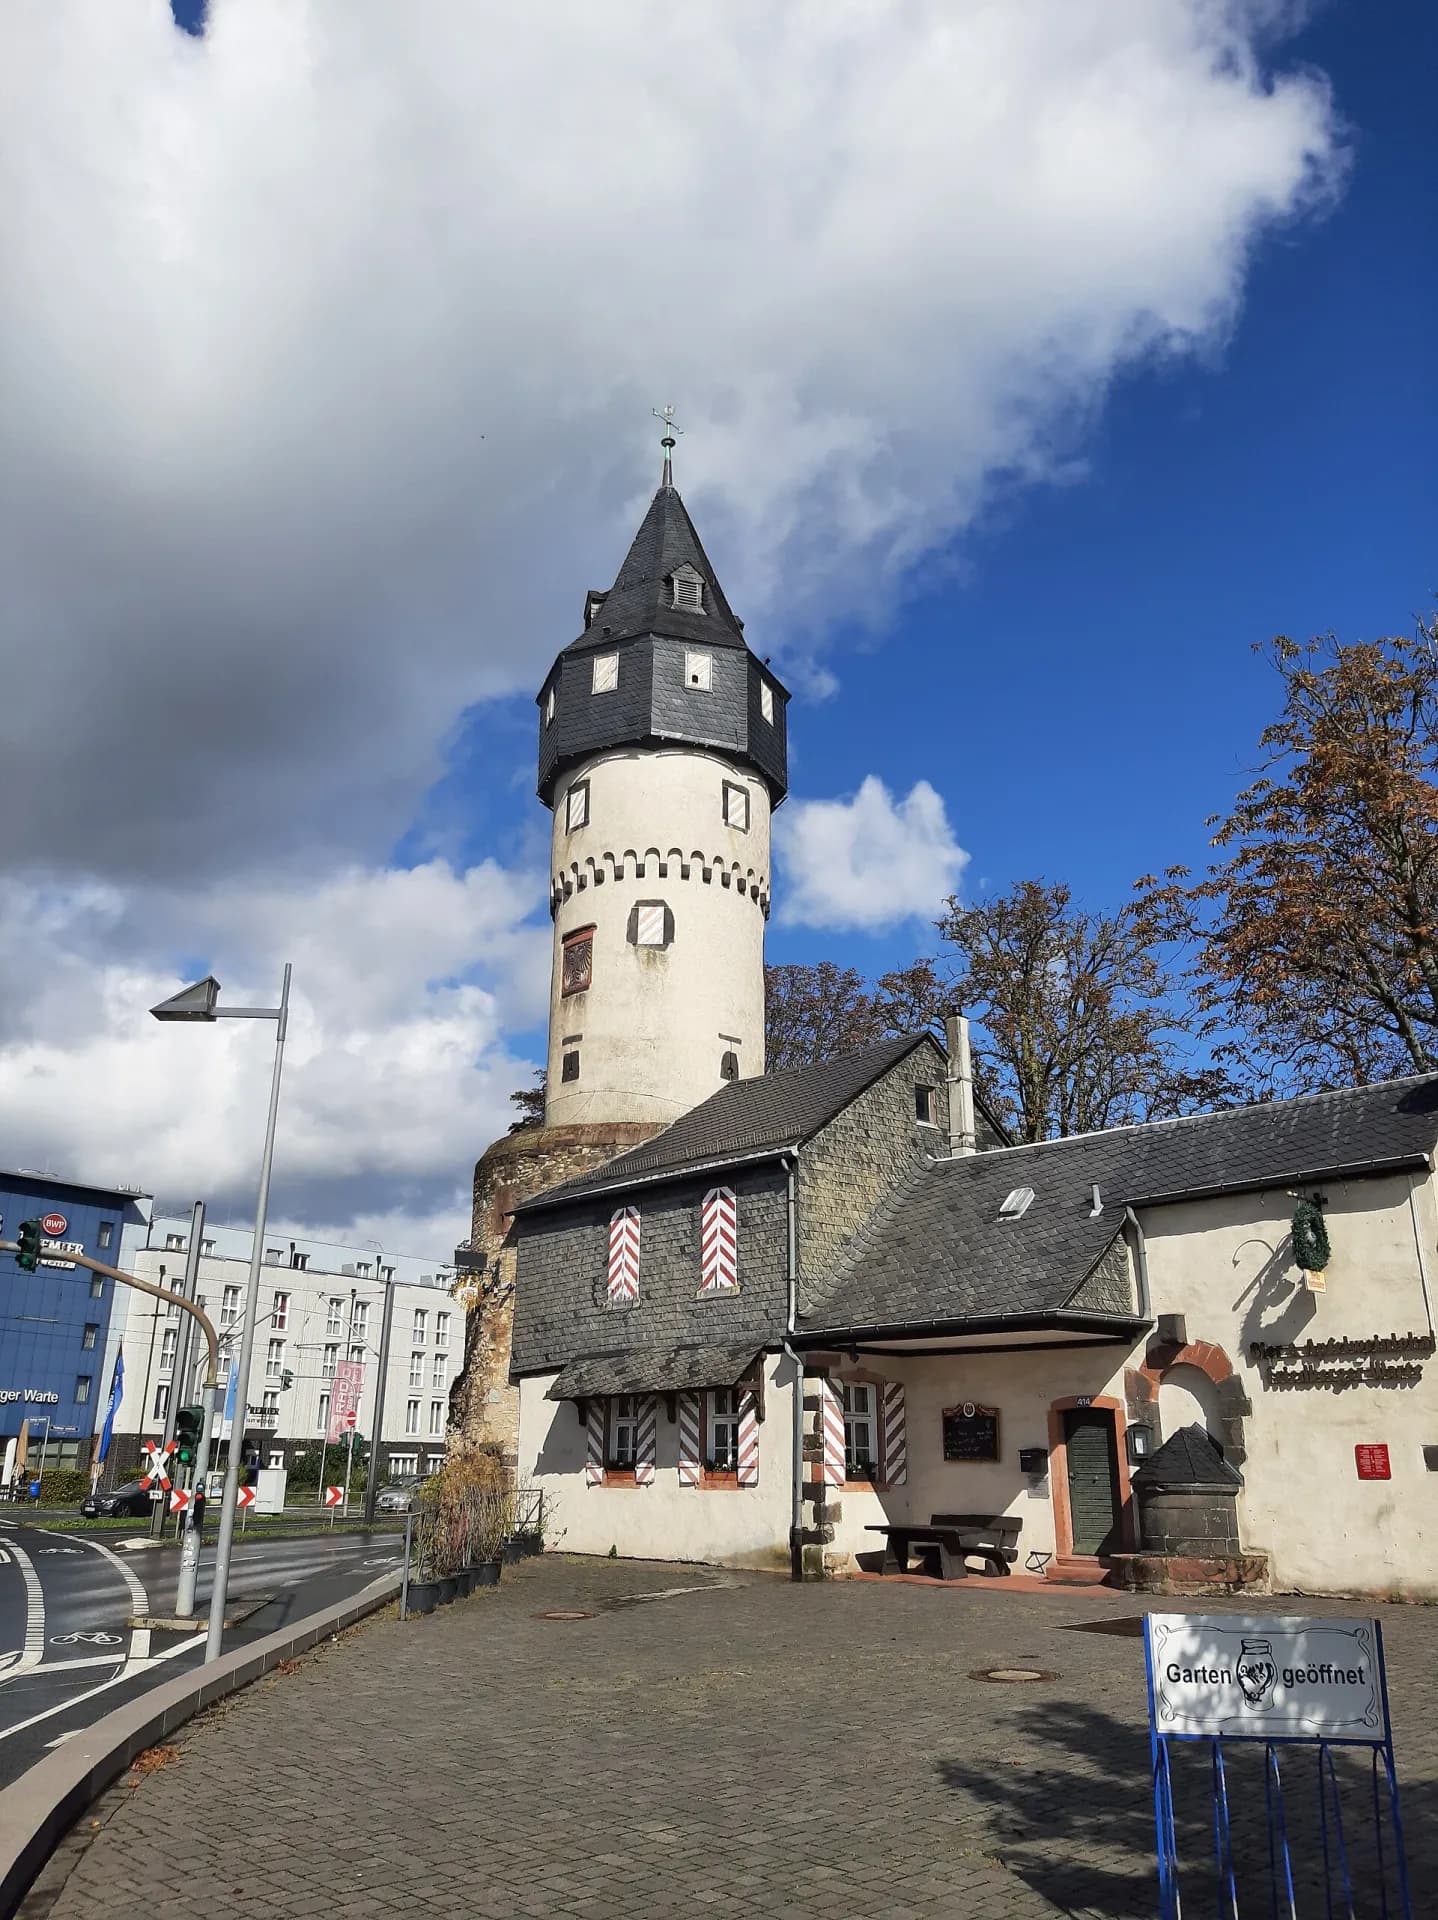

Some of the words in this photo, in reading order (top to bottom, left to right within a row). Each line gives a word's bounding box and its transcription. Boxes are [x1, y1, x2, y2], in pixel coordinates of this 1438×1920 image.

[46, 1219, 65, 1229] BWP
[0, 1390, 21, 1403] ger
[24, 1389, 59, 1403] Warte
[1077, 1398, 1090, 1406] 414
[1166, 1663, 1232, 1685] Garten
[1282, 1663, 1366, 1688] geöffnet
